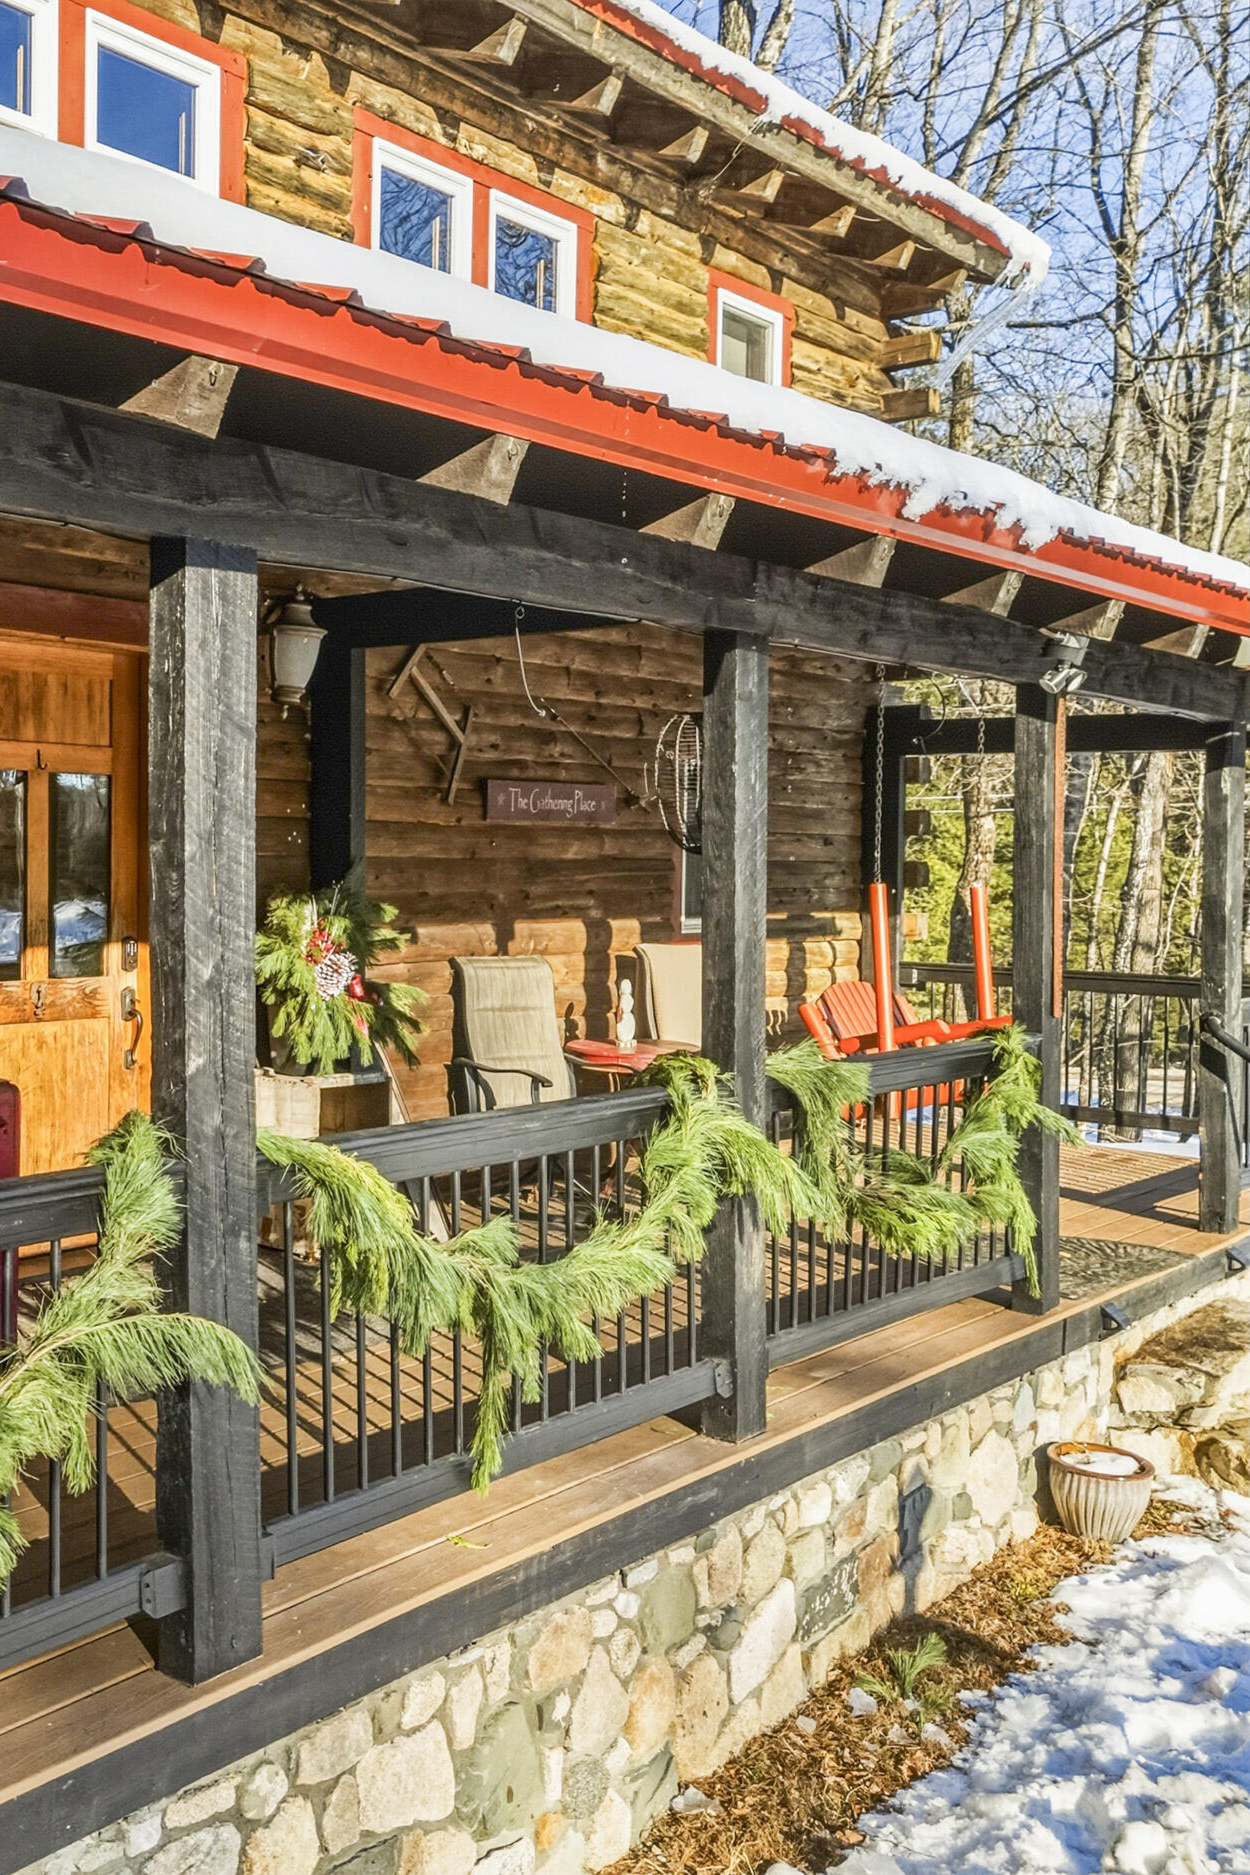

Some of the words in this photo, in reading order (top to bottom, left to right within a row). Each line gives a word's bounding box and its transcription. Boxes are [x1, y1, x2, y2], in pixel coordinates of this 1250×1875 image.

[508, 787, 529, 812] The
[529, 787, 574, 818] Gathering
[573, 789, 598, 814] Place
